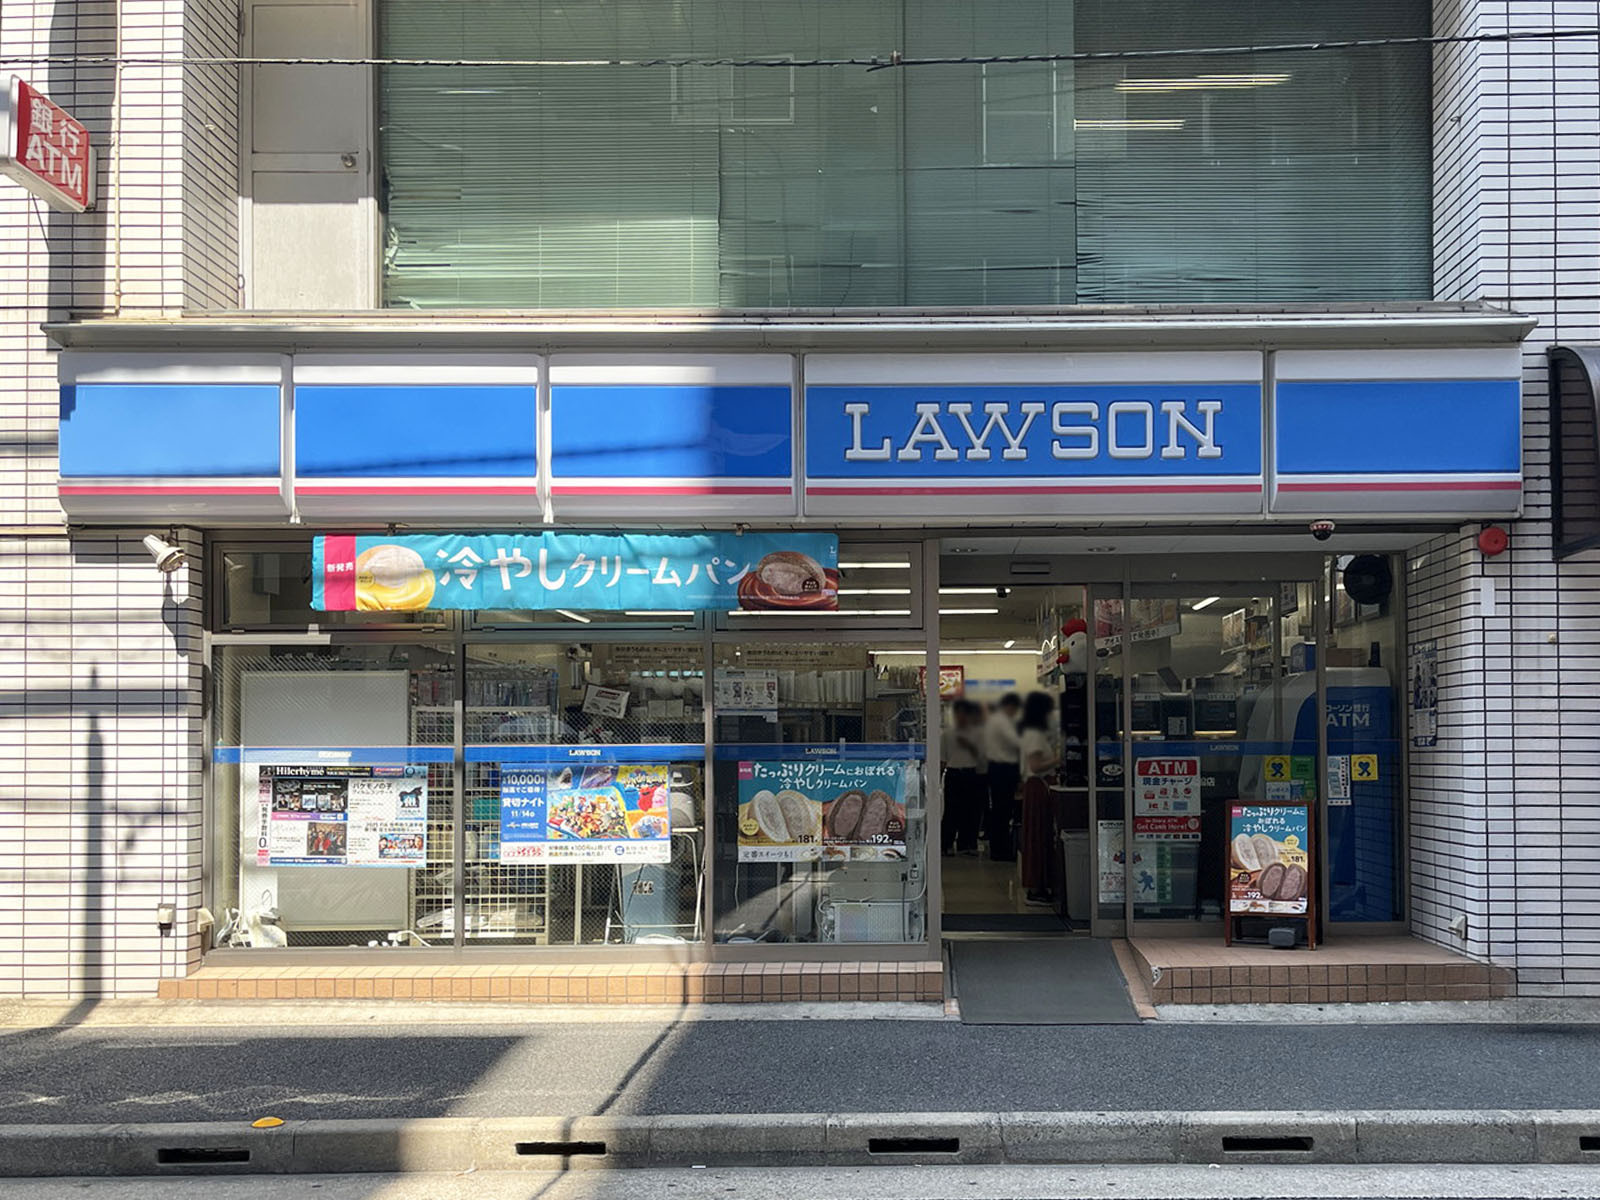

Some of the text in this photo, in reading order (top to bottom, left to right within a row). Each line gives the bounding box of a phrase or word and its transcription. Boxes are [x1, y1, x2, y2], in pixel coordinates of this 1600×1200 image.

[30, 97, 80, 156] 銀行
[25, 133, 82, 195] ATM
[843, 400, 1224, 462] LAWSON
[326, 561, 355, 573] 新発売
[436, 545, 752, 592] 冷やしクリームパン
[1326, 713, 1371, 727] ATM
[568, 748, 603, 757] LAWSON
[804, 747, 838, 755] LAWSON
[753, 762, 896, 779] たっぷりクリームにおぼれる
[1148, 761, 1188, 775] ATM
[779, 778, 868, 790] 冷やしクリームパン
[798, 834, 815, 844] 181
[871, 834, 889, 844] 192
